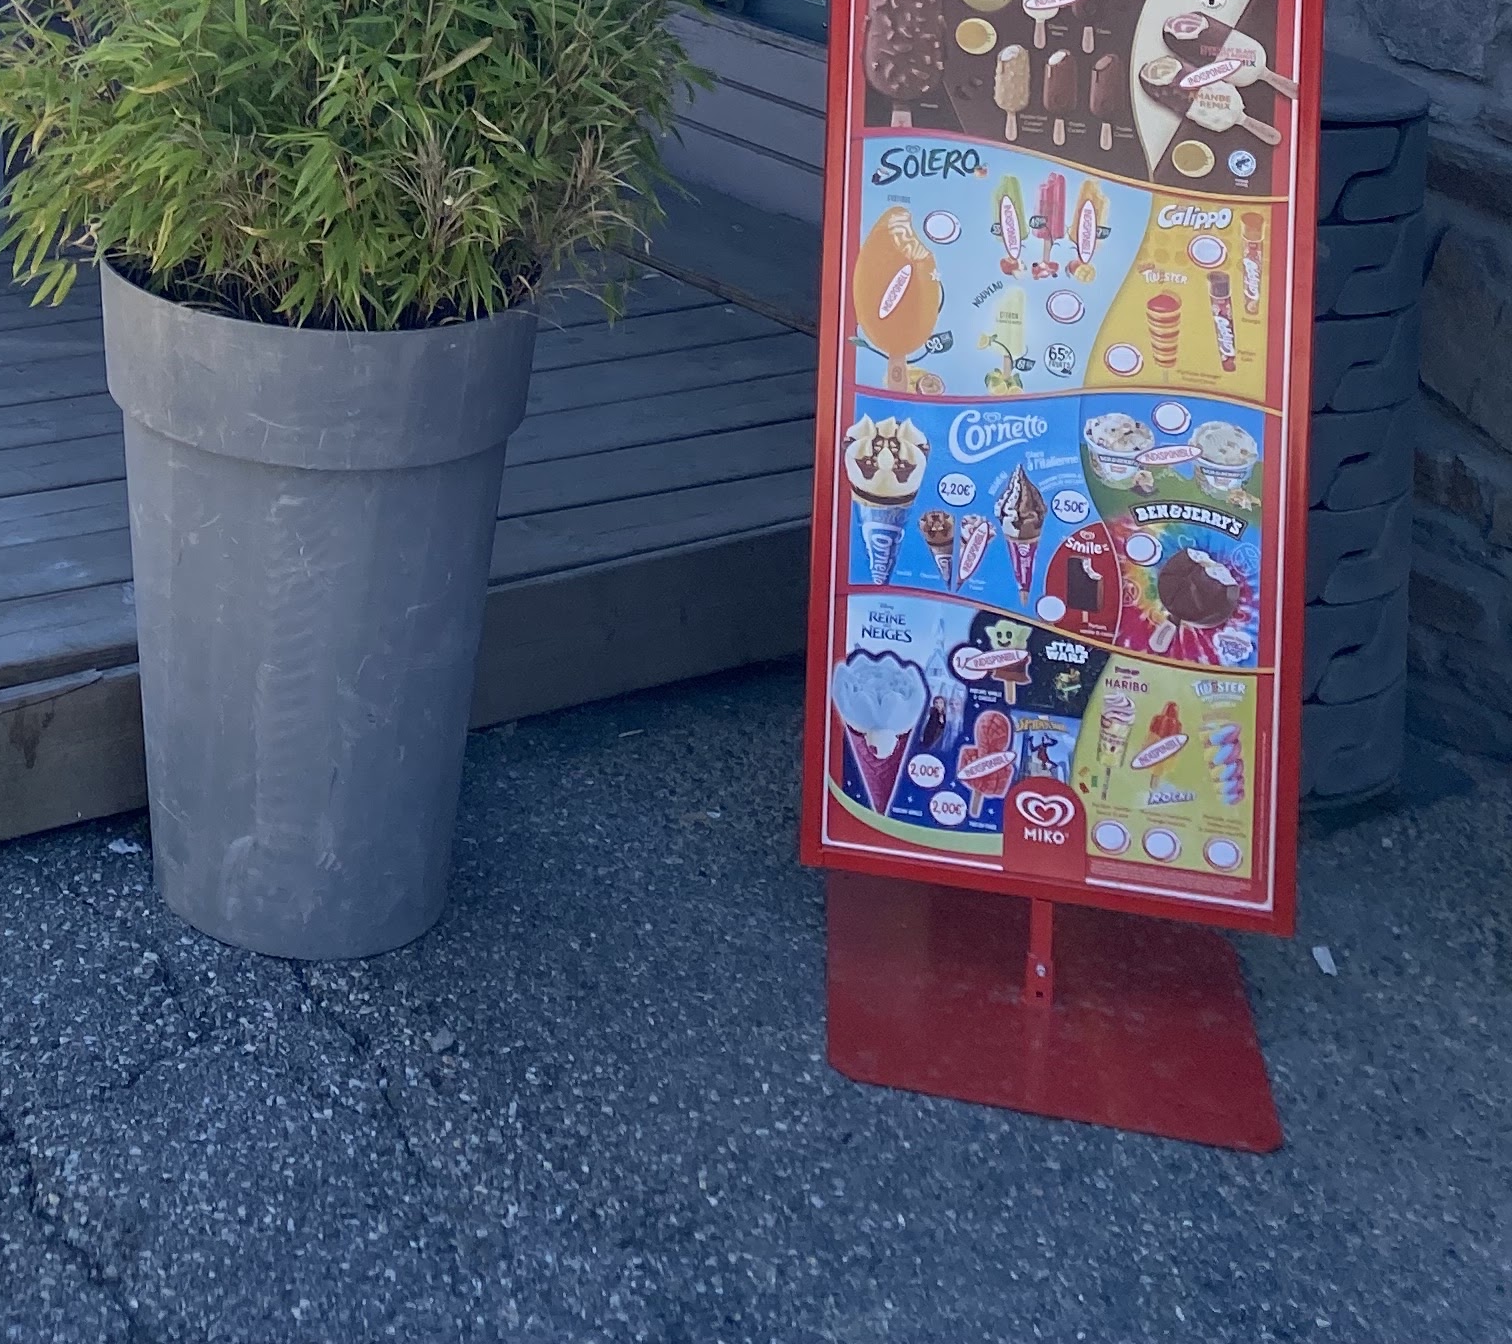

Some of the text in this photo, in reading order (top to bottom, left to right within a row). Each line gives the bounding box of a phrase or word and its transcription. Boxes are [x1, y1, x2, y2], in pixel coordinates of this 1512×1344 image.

[872, 147, 981, 185] SOLERO
[1157, 204, 1233, 230] Calippo
[1048, 346, 1074, 362] 65%
[949, 409, 1048, 463] Cornetto
[1065, 538, 1103, 555] smile
[869, 611, 907, 626] REINE
[861, 624, 912, 643] NEIGES
[1046, 640, 1087, 654] STAR
[1047, 651, 1089, 665] WARS
[1105, 678, 1149, 693] HARIBO
[1023, 827, 1065, 845] MIKO
